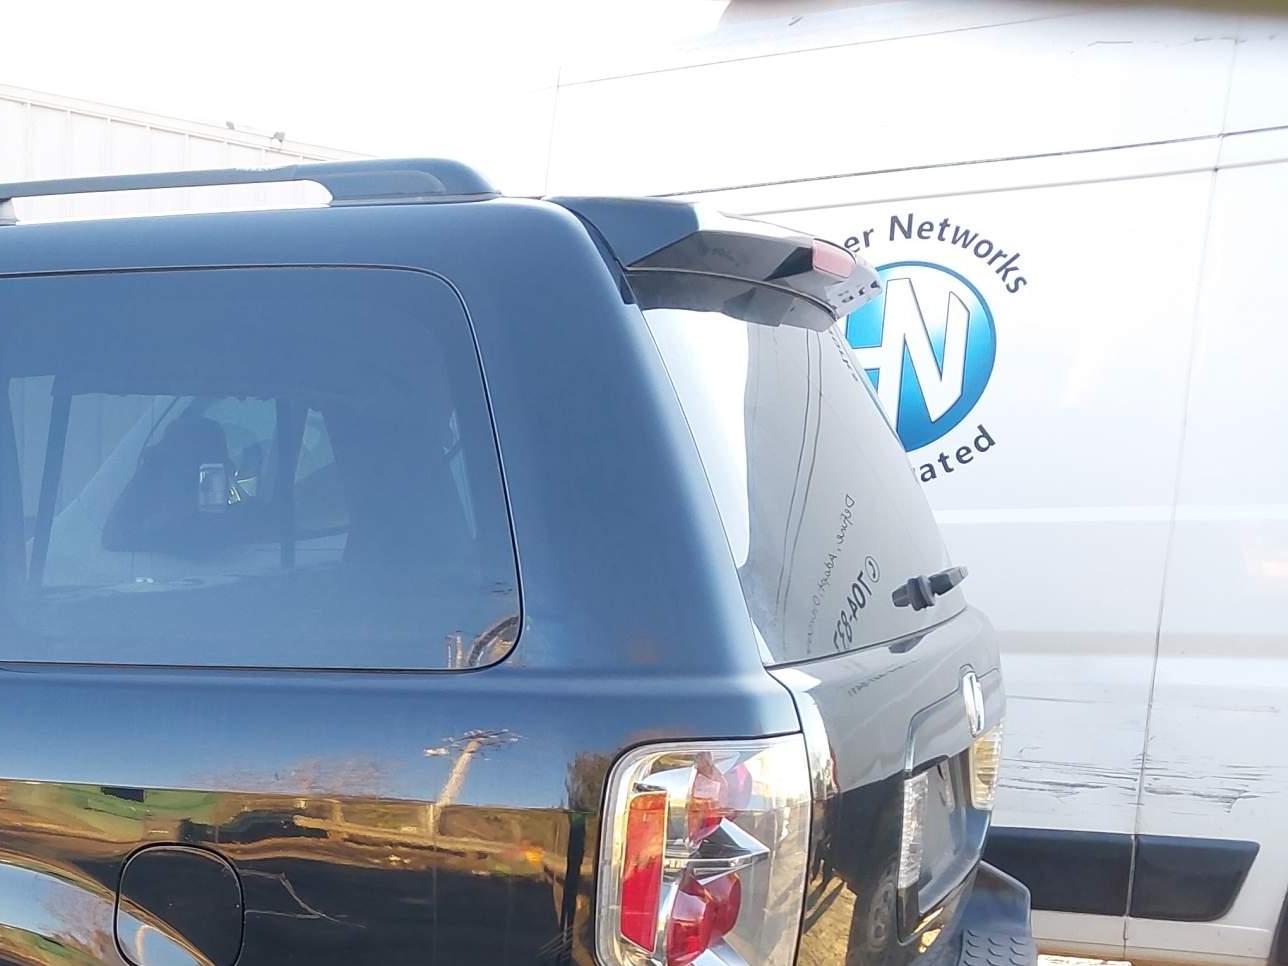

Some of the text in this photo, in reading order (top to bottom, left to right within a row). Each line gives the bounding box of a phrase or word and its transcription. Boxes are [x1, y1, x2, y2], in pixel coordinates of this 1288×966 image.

[844, 227, 875, 252] er
[888, 212, 1028, 294] Networks
[916, 424, 996, 483] ated
